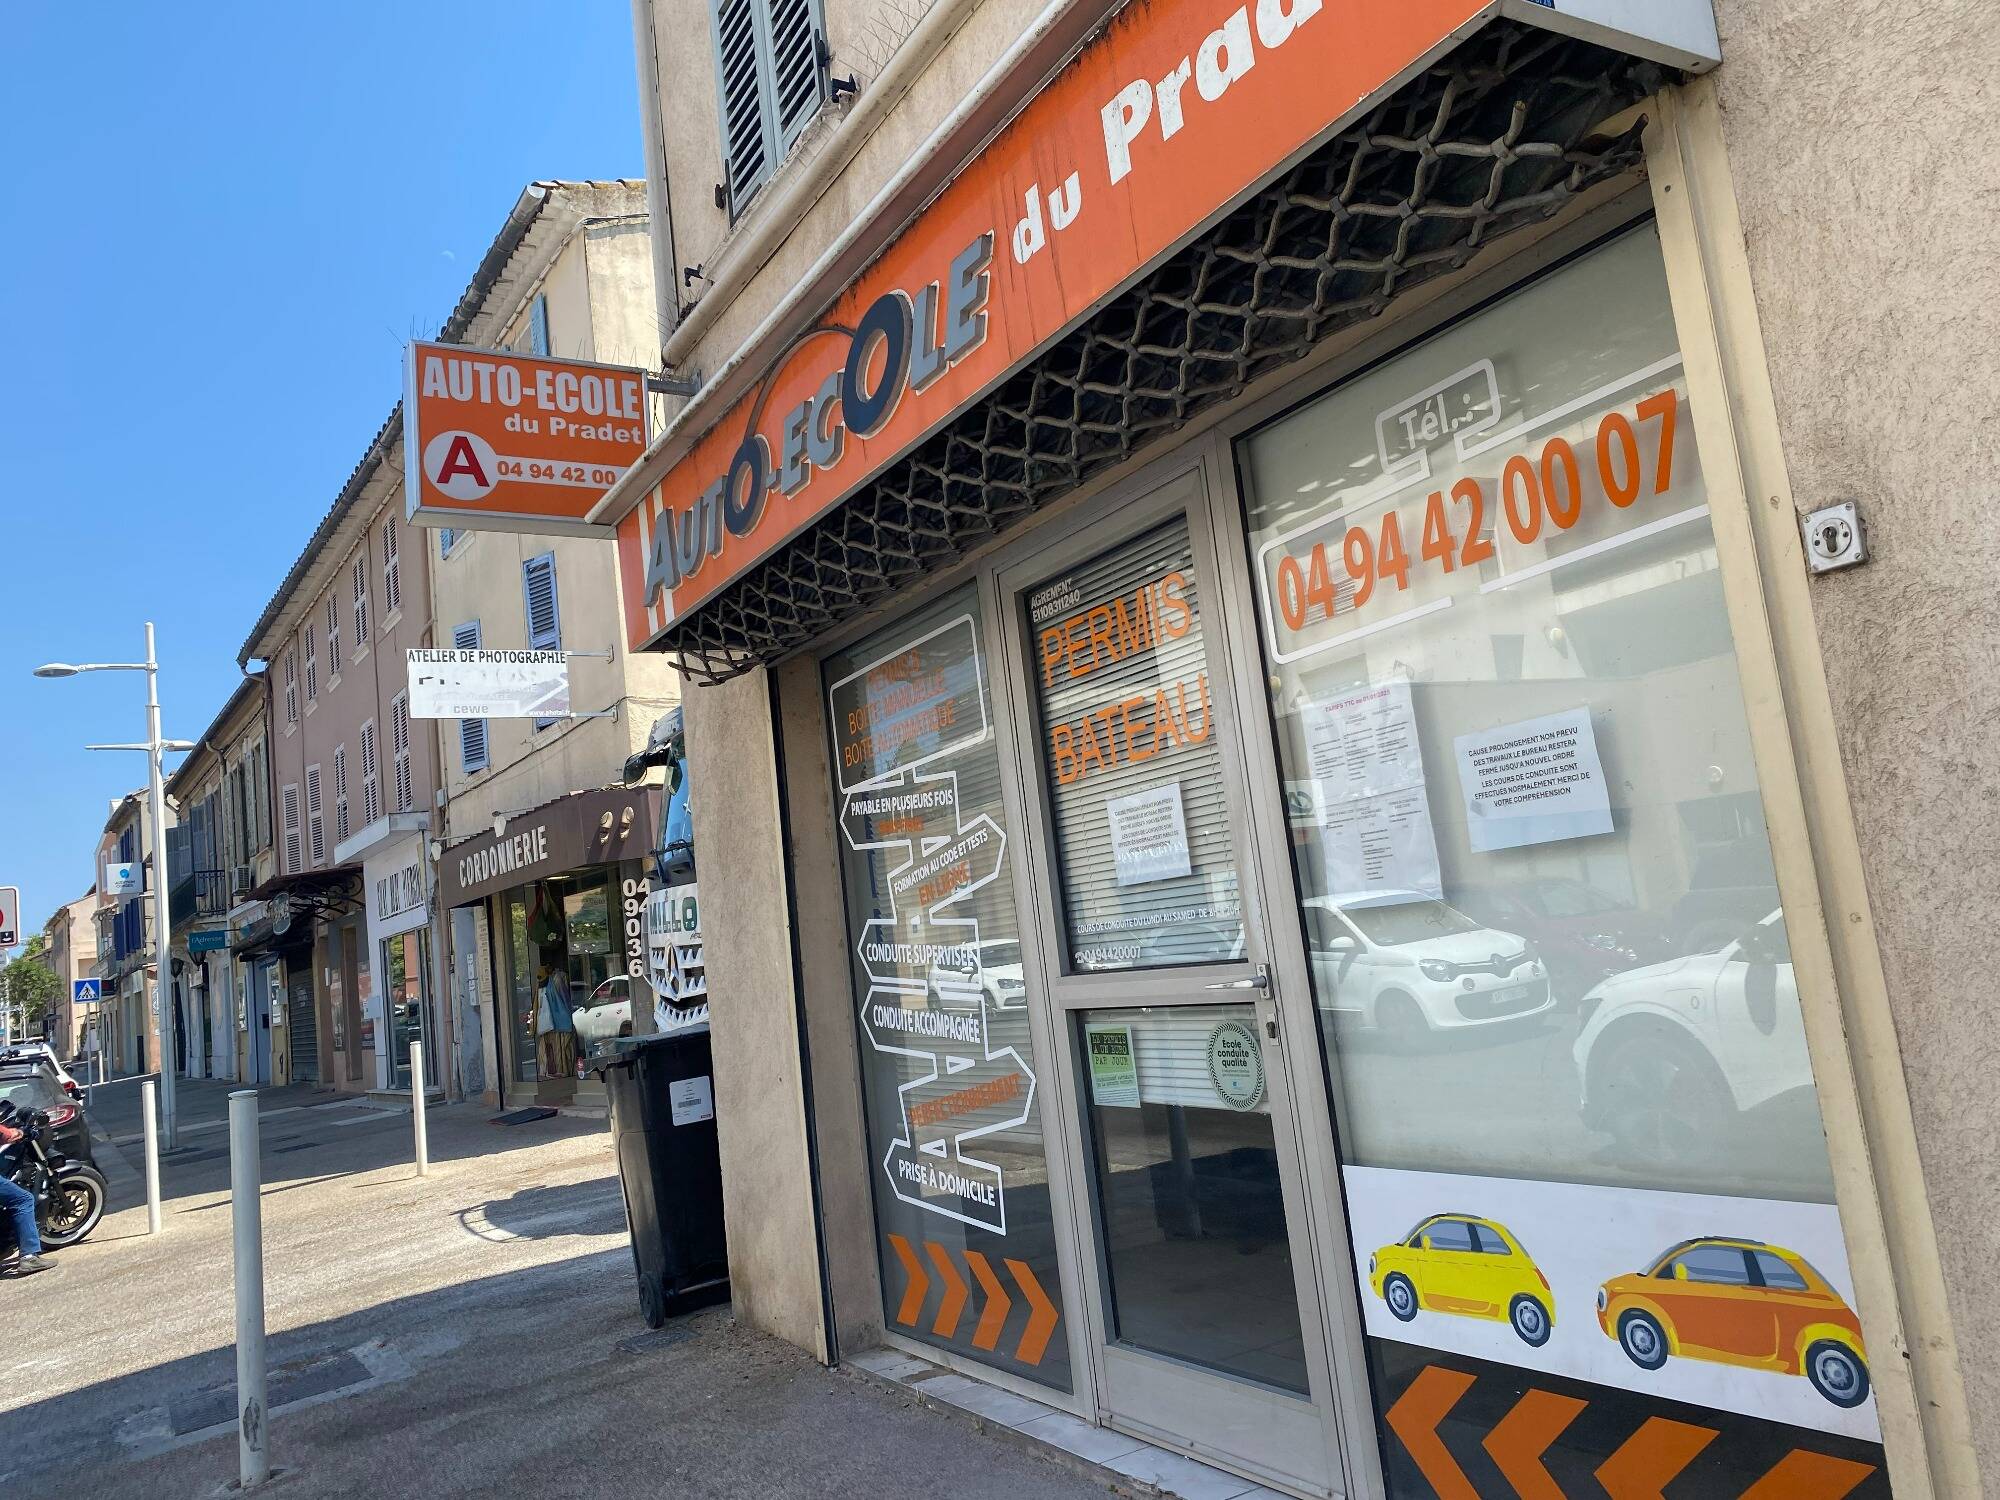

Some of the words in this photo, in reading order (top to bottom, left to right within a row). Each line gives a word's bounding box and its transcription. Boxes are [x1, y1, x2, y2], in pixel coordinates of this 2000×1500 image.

[423, 356, 639, 420] AUTO-ECOLE
[645, 229, 995, 607] AUTO-ECOLE
[1013, 170, 1083, 264] du
[504, 413, 539, 434] du
[550, 416, 642, 445] Pradet
[436, 435, 490, 487] A
[497, 460, 523, 477] 04
[529, 463, 554, 480] 94
[560, 466, 586, 482] 42
[592, 468, 616, 485] 00
[1277, 543, 1336, 632] 04
[1343, 510, 1412, 608] 94
[1421, 477, 1494, 574] 42
[1502, 437, 1582, 545] 00
[1596, 388, 1678, 508] 07
[1041, 572, 1193, 688] PERMIS
[408, 650, 456, 663] ATELIER
[460, 651, 475, 663] DE
[479, 651, 566, 664] PHOTOGRAPHIE
[453, 705, 489, 713] cewe
[1051, 672, 1211, 785] BATEAU
[1468, 747, 1488, 757] CAUSE
[1489, 736, 1539, 752] PROLONGEMENT
[1540, 732, 1555, 741] NON
[1556, 726, 1578, 738] PREVU
[844, 736, 875, 767] BOITE
[1473, 758, 1486, 767] DES
[1486, 752, 1513, 764] TRAVAUX
[1513, 750, 1521, 758] LE
[1522, 745, 1547, 757] BUREAU
[1548, 739, 1577, 751] RESTERA
[1525, 756, 1552, 767] NOUVEL
[1553, 750, 1575, 761] ORDRE
[1474, 787, 1507, 800] EFFECTUES
[1508, 778, 1555, 793] NORMALEMENT
[1557, 774, 1579, 784] MERCI
[1580, 772, 1590, 781] DE
[1482, 779, 1493, 788] LES
[1493, 775, 1515, 786] COURS
[1515, 773, 1524, 782] DE
[1525, 767, 1558, 779] CONDUITE
[1559, 762, 1578, 772] SONT
[851, 798, 880, 816] PAYABLE
[880, 797, 892, 813] EN
[892, 791, 933, 811] PLUSIEURS
[934, 789, 954, 807] FOIS
[1494, 798, 1513, 807] VOTRE
[459, 825, 548, 888] CORDONNERIE
[893, 863, 931, 895] FORMATION
[930, 857, 940, 874] AU
[940, 845, 959, 867] CODE
[958, 839, 967, 857] ET
[966, 827, 988, 851] TESTS
[622, 877, 651, 897] 04
[1077, 923, 1096, 934] COURS
[1096, 922, 1104, 932] DE
[1104, 918, 1133, 930] CONDUITE
[1133, 917, 1142, 926] DU
[1143, 913, 1162, 926] LUNDI
[1163, 912, 1172, 923] AU
[1172, 909, 1197, 922] SAMED
[1198, 908, 1207, 918] DE
[866, 943, 912, 964] CONDUITE
[913, 941, 974, 967] SUPERVISÉE
[873, 1004, 913, 1033] CONDUITE
[914, 1010, 981, 1044] ACCOMPAGNÉE
[1217, 1048, 1250, 1058] conduite
[1222, 1037, 1242, 1048] École
[1095, 1056, 1108, 1065] PAR
[1112, 1056, 1129, 1066] JOUR
[1221, 1058, 1248, 1068] qualité
[899, 1159, 928, 1185] PRISE
[929, 1162, 938, 1189] À
[938, 1170, 996, 1207] DOMICILE
